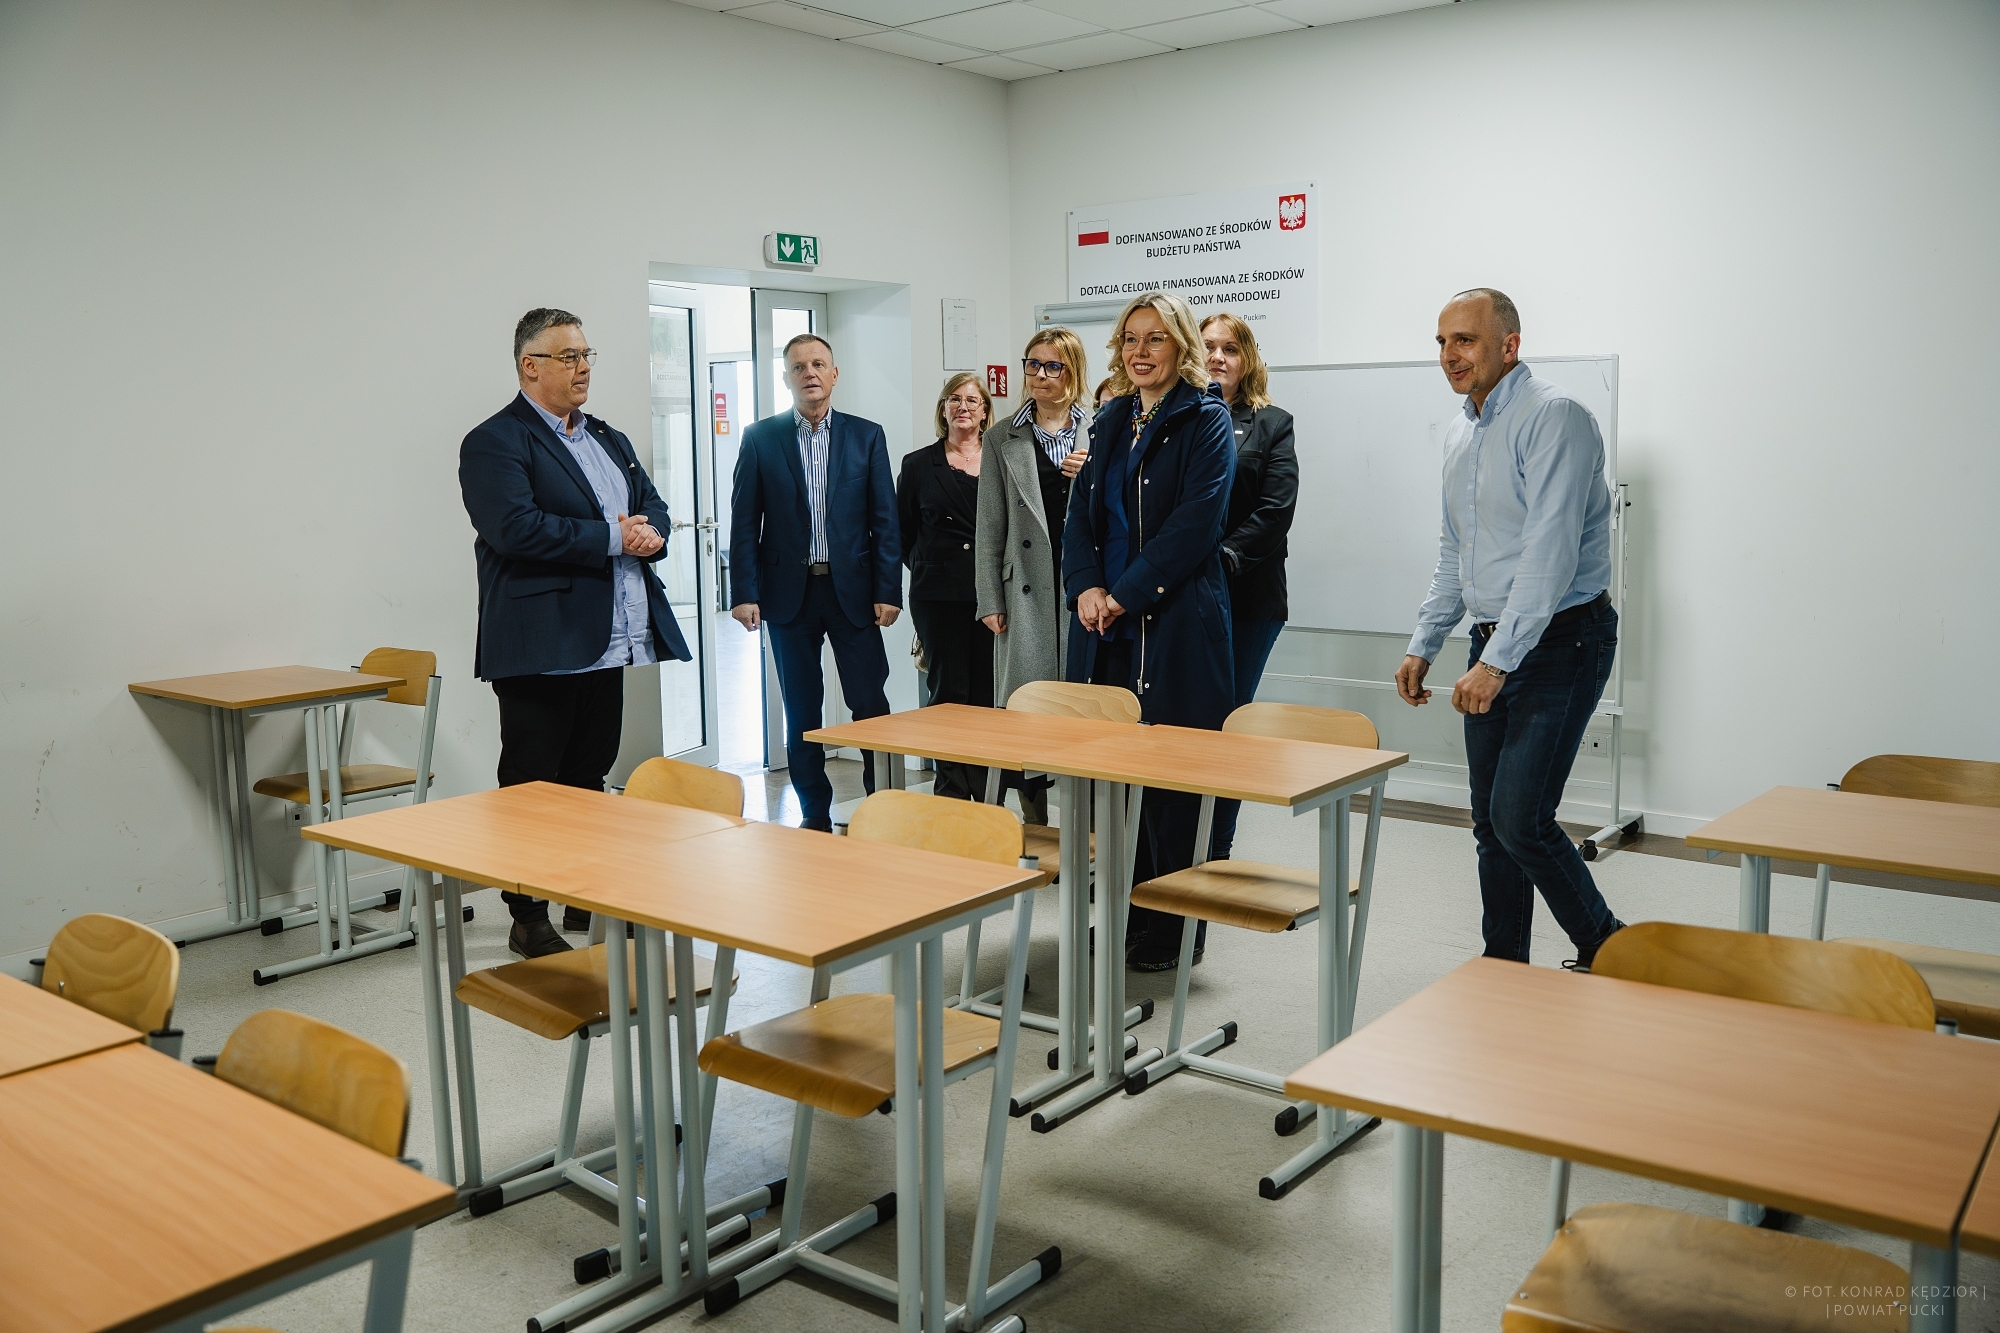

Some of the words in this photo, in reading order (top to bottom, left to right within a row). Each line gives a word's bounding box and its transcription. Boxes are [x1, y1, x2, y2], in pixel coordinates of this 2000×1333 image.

[1116, 227, 1204, 245] DOFINANSOWANO
[1206, 226, 1217, 236] ZE
[1220, 218, 1272, 234] ŚRODKÓW
[1146, 244, 1190, 258] BUDŻETU
[1193, 240, 1241, 254] PAŃSTWA
[1080, 284, 1120, 296] DOTACJA
[1122, 280, 1160, 294] CELOWA
[1162, 274, 1236, 290] FINANSOWANA
[1238, 272, 1250, 284] ZE
[1252, 266, 1304, 282] ŚRODKÓW
[1188, 294, 1214, 306] RONY
[1216, 289, 1280, 304] NARODOWEJ
[1243, 314, 1266, 322] Puckim
